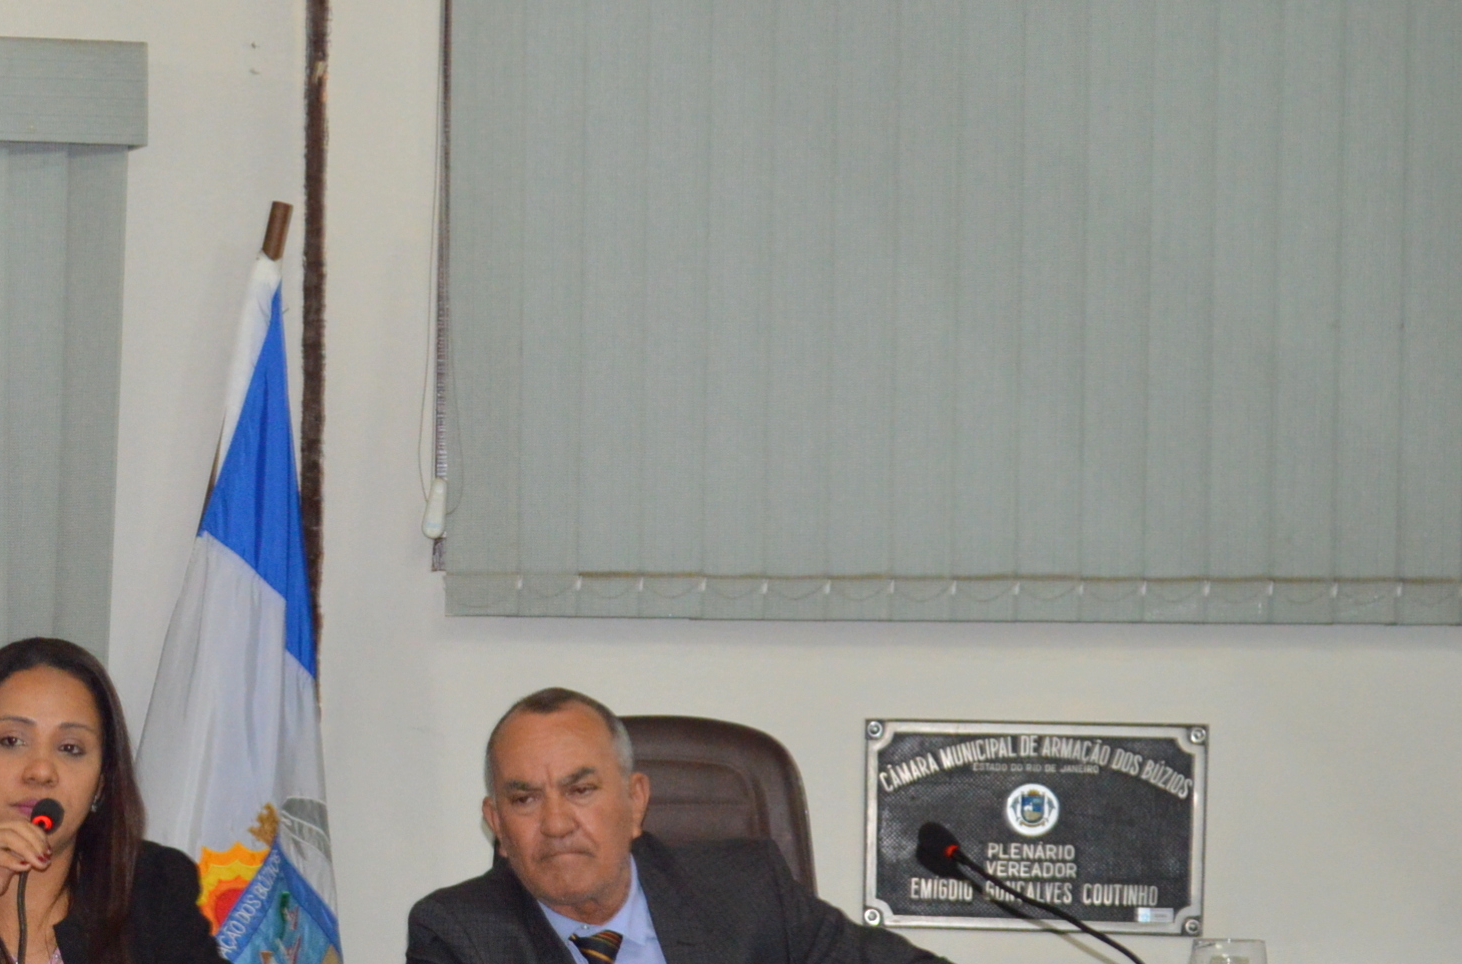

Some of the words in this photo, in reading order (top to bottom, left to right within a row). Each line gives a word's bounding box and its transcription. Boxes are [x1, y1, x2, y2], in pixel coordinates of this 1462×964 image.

[879, 751, 940, 793] CÂMARA
[939, 736, 1017, 770] MUNICIPAL
[1020, 735, 1038, 757] DE
[1041, 736, 1112, 766] ARMAÇÃO
[1111, 748, 1143, 776] DOS
[1141, 759, 1194, 800] BÚZIOS
[972, 762, 1008, 773] ESTADO
[1010, 763, 1024, 773] DO
[1025, 763, 1042, 773] RIO
[1044, 764, 1057, 773] DE
[1060, 764, 1100, 774] JANEIRO
[987, 841, 1075, 861] PLENÁRIO
[986, 861, 1078, 878] VEREADOR
[1082, 883, 1159, 907] COUTINHO
[235, 894, 262, 924] DOS
